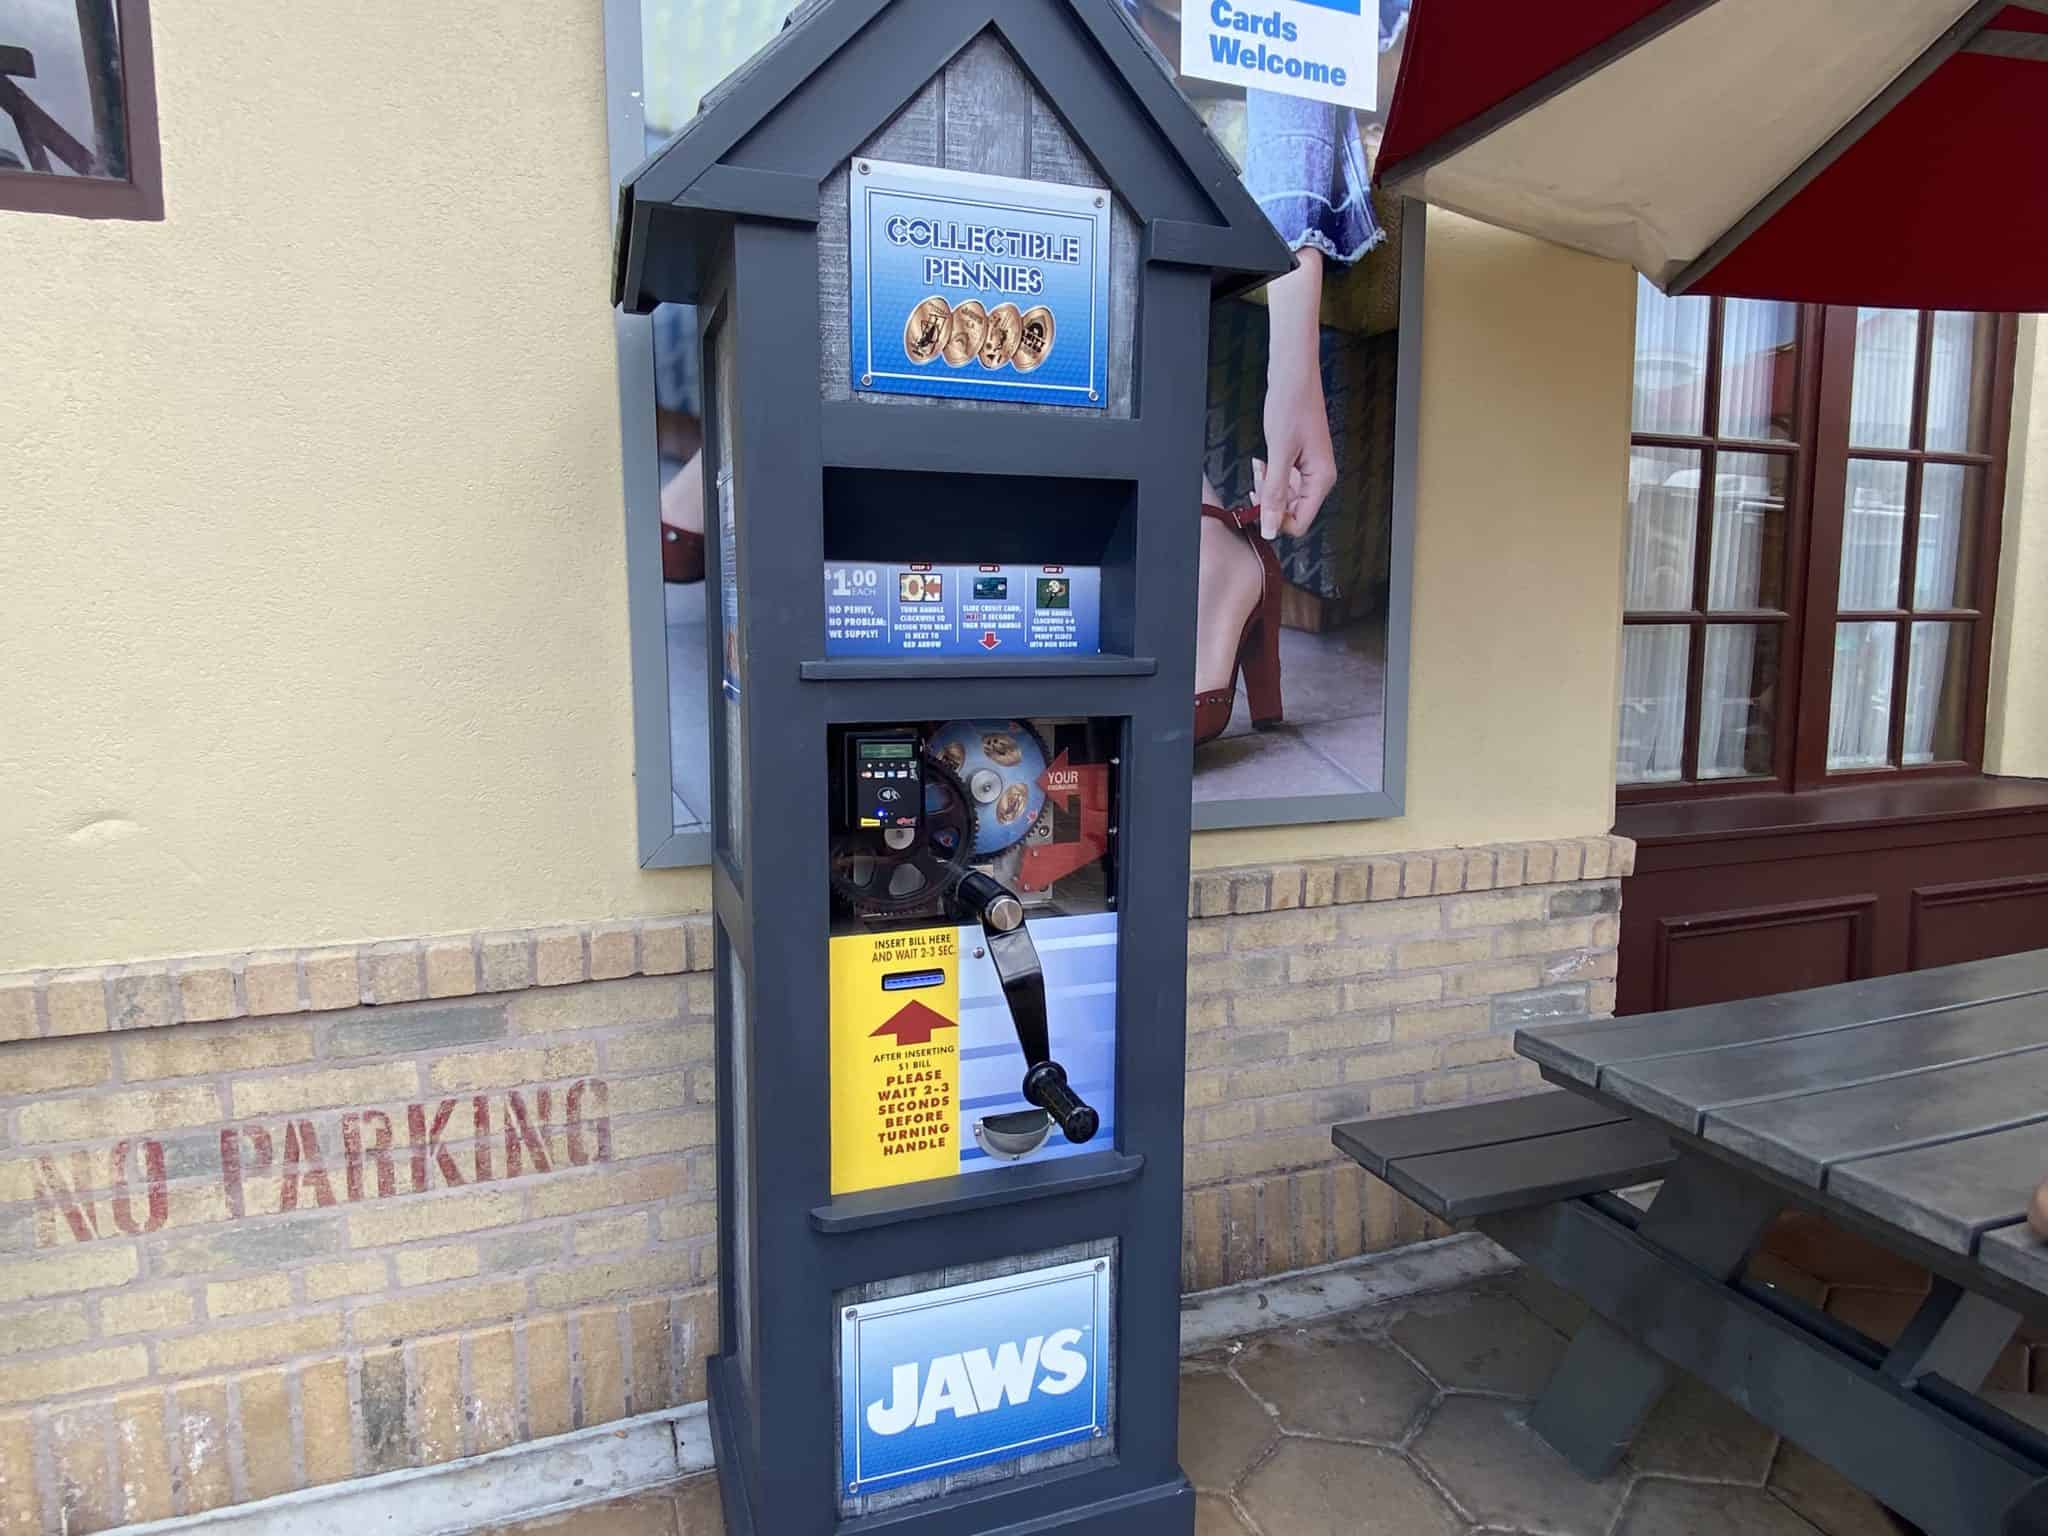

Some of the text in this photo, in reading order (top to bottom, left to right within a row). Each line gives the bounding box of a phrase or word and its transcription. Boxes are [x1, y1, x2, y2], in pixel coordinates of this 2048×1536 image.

[1211, 0, 1297, 41] Cards
[1209, 34, 1347, 86] Welcome
[886, 215, 1080, 264] COLLECTIBLE
[923, 256, 1042, 294] PENNIES
[829, 617, 842, 626] NO
[829, 629, 843, 639] WE
[1048, 770, 1079, 784] YOUR
[874, 933, 951, 950] INSERT BILL HERE
[872, 951, 893, 962] AND
[895, 948, 918, 960] WAIT
[920, 946, 935, 958] 2-3
[874, 1045, 955, 1063] AFTER INSERTING
[898, 1059, 931, 1071] $1 BILL
[886, 1069, 942, 1087] PLEASE
[878, 1082, 949, 1101] WAIT 2-3
[878, 1095, 950, 1115] SECONDS
[885, 1110, 943, 1128] BEFORE
[878, 1123, 950, 1143] TURNING
[883, 1137, 946, 1156] HANDLE
[34, 1079, 611, 1248] NO PARKING
[867, 1328, 1087, 1436] JAWS
